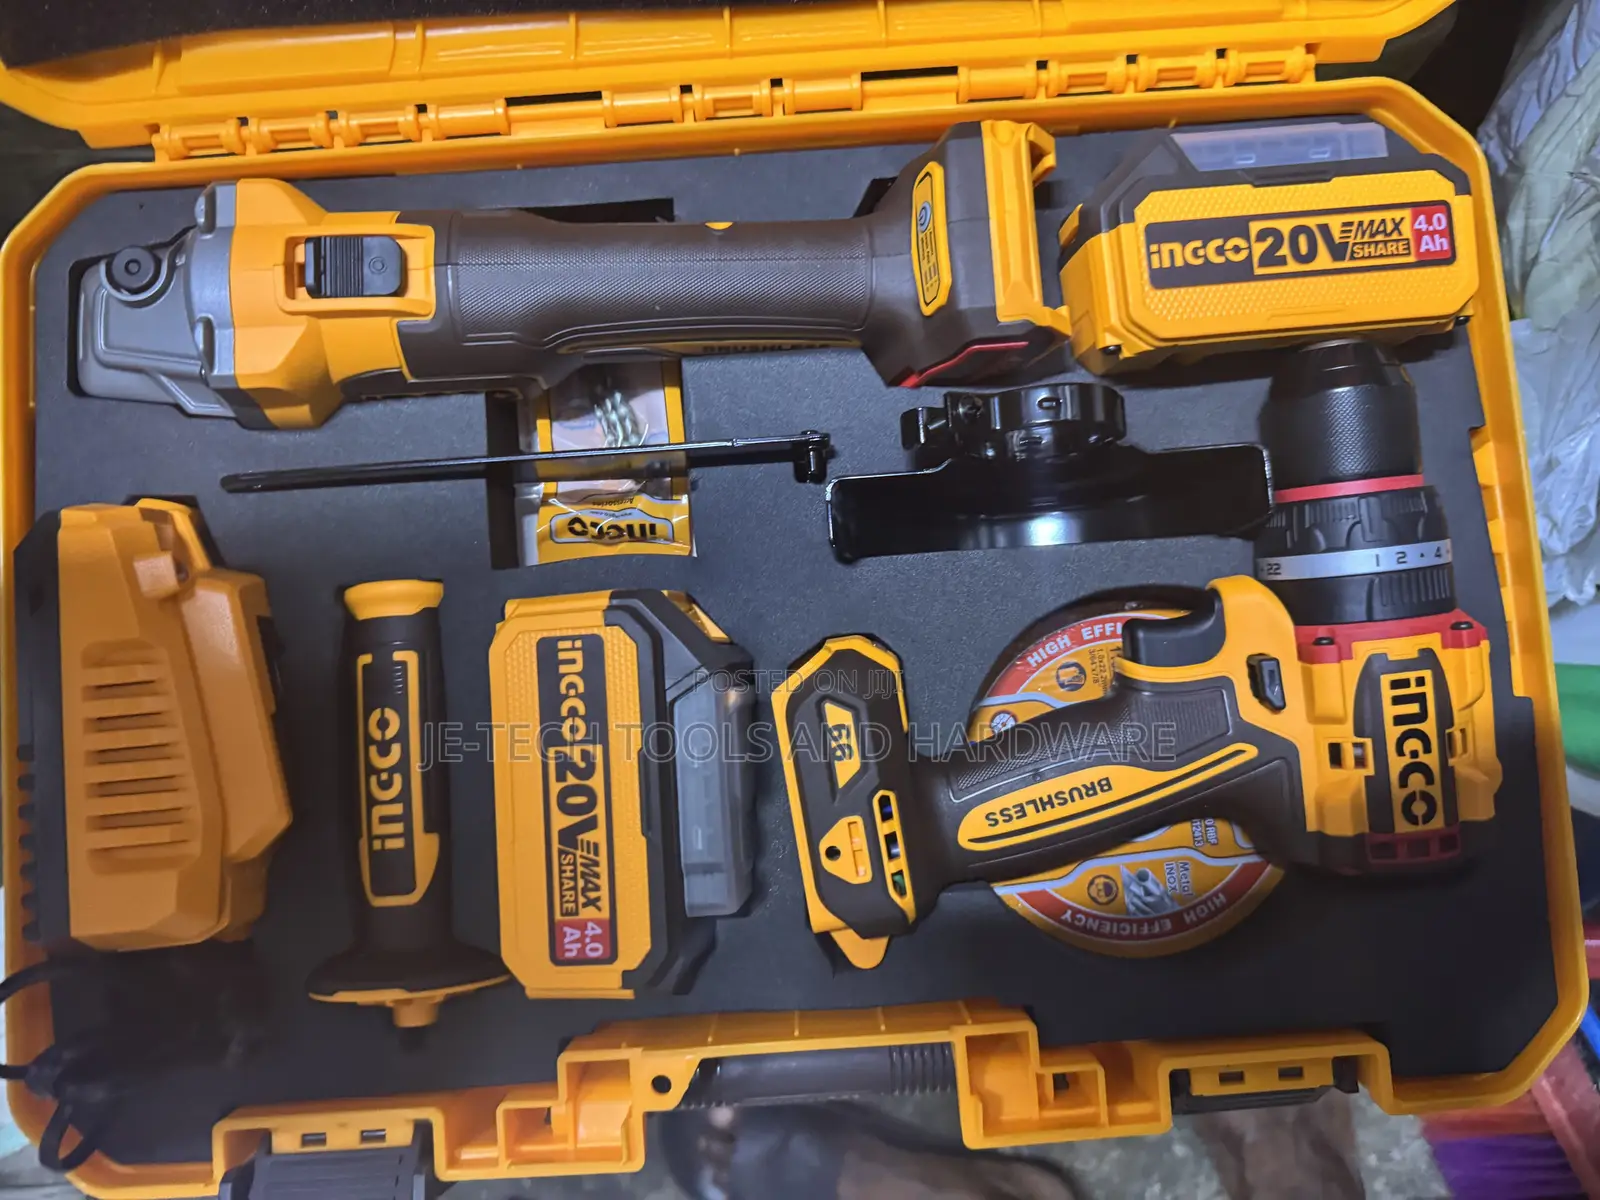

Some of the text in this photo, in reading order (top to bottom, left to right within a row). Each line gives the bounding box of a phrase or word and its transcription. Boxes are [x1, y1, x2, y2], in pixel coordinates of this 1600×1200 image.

[1353, 217, 1405, 240] MAX
[1413, 212, 1447, 232] 4.0
[1254, 223, 1351, 268] 20V
[1352, 240, 1409, 259] SHARE
[1419, 234, 1448, 253] Ah
[1267, 547, 1442, 575] 22 1 2 4
[1027, 634, 1071, 667] HIGH
[554, 748, 599, 851] 20V
[985, 776, 1113, 828] BRUSHLESS
[560, 853, 577, 914] SHARE
[579, 854, 602, 912] MAX
[1165, 862, 1178, 893] INOX
[1179, 861, 1194, 896] Metal
[1061, 892, 1227, 936] HIGH EFFICIENCY
[562, 926, 582, 958] Ah
[585, 921, 604, 958] 4.0
